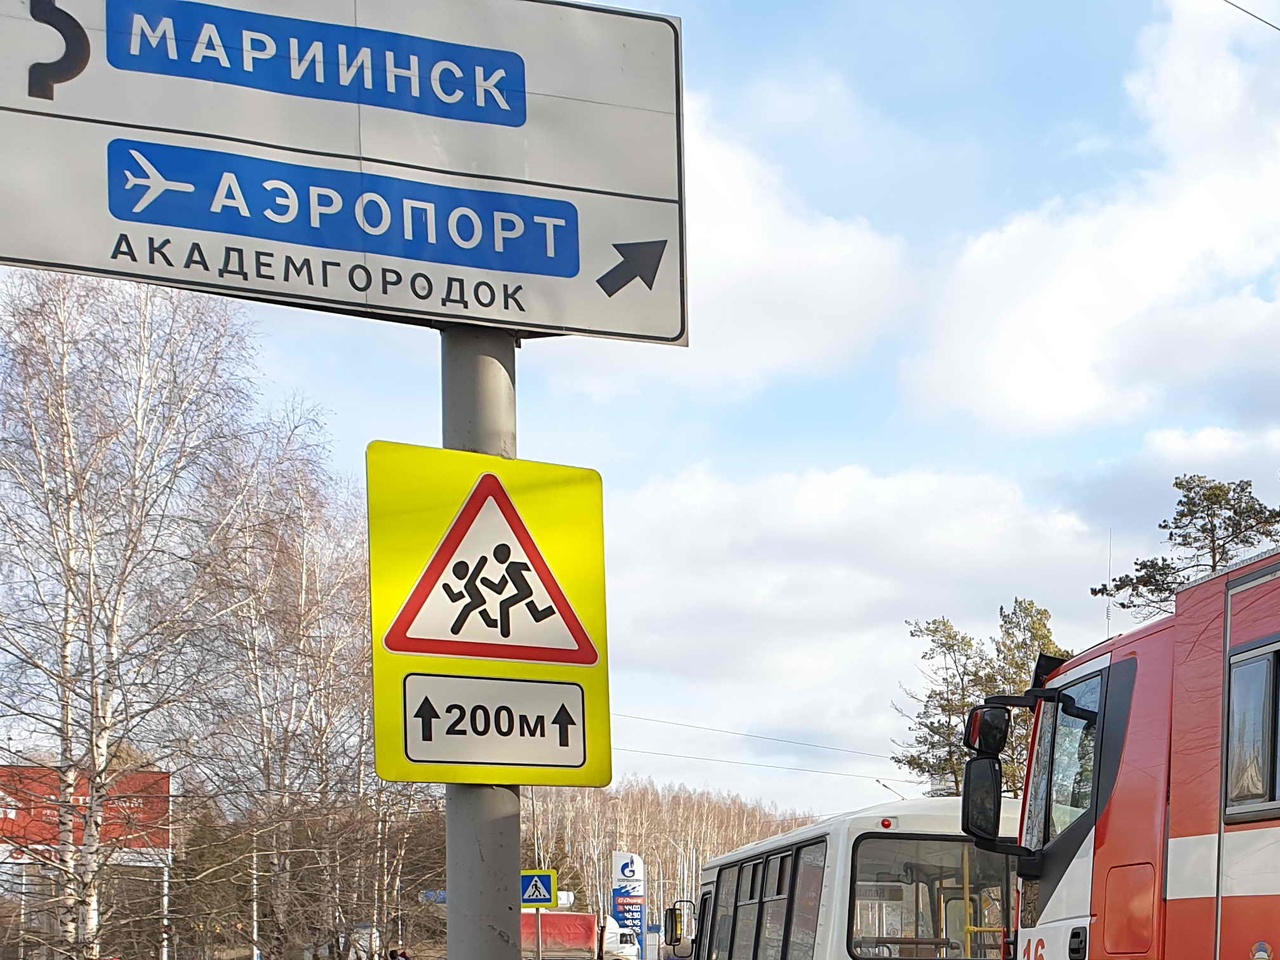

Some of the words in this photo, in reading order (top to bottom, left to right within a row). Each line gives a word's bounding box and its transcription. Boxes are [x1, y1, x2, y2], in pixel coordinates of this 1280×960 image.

[129, 14, 512, 111] МАРИИНСК
[209, 172, 567, 258] АЭРОПОРТ
[110, 233, 526, 313] АКАДЕМГОРОДОК
